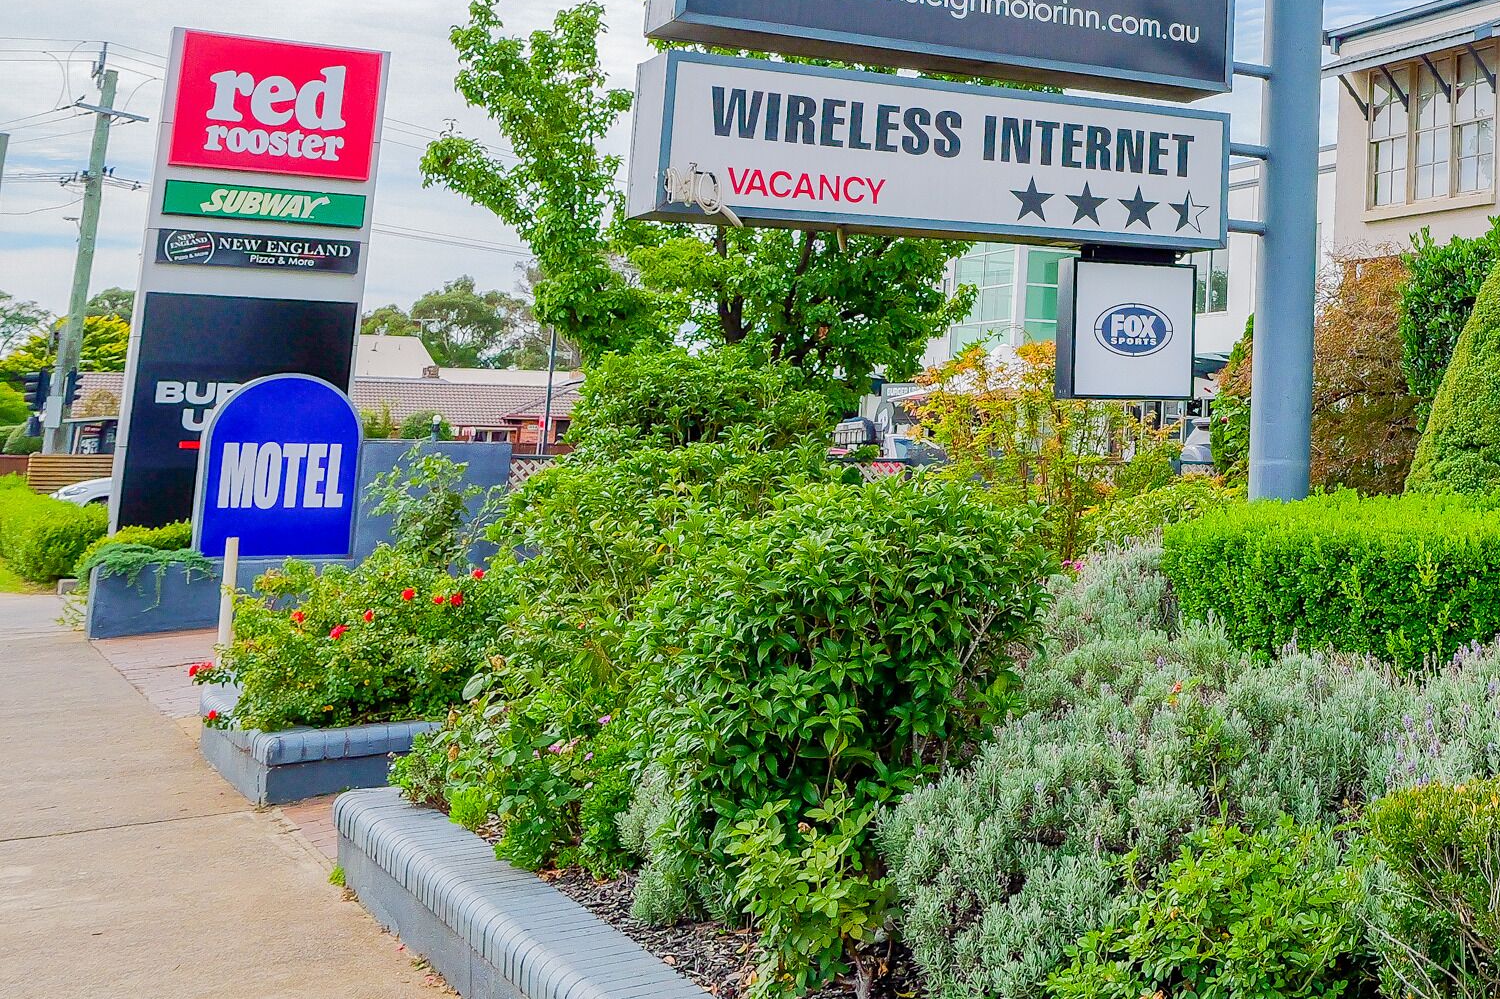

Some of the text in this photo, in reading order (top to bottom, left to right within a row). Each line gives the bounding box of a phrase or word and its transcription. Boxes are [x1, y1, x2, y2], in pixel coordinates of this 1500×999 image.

[205, 65, 347, 131] red
[203, 124, 344, 162] rooster
[711, 85, 1195, 178] WIRELESS INTERNET
[728, 167, 885, 204] VACANCY
[200, 188, 331, 219] SUBWAY
[170, 237, 208, 249] ENGLAND
[177, 232, 197, 241] NEW
[218, 237, 351, 257] NEW ENGLAND
[250, 254, 315, 267] Pizza & More
[1110, 313, 1157, 339] FOX
[1110, 337, 1157, 346] SPORTS
[217, 441, 344, 509] MOTEL
